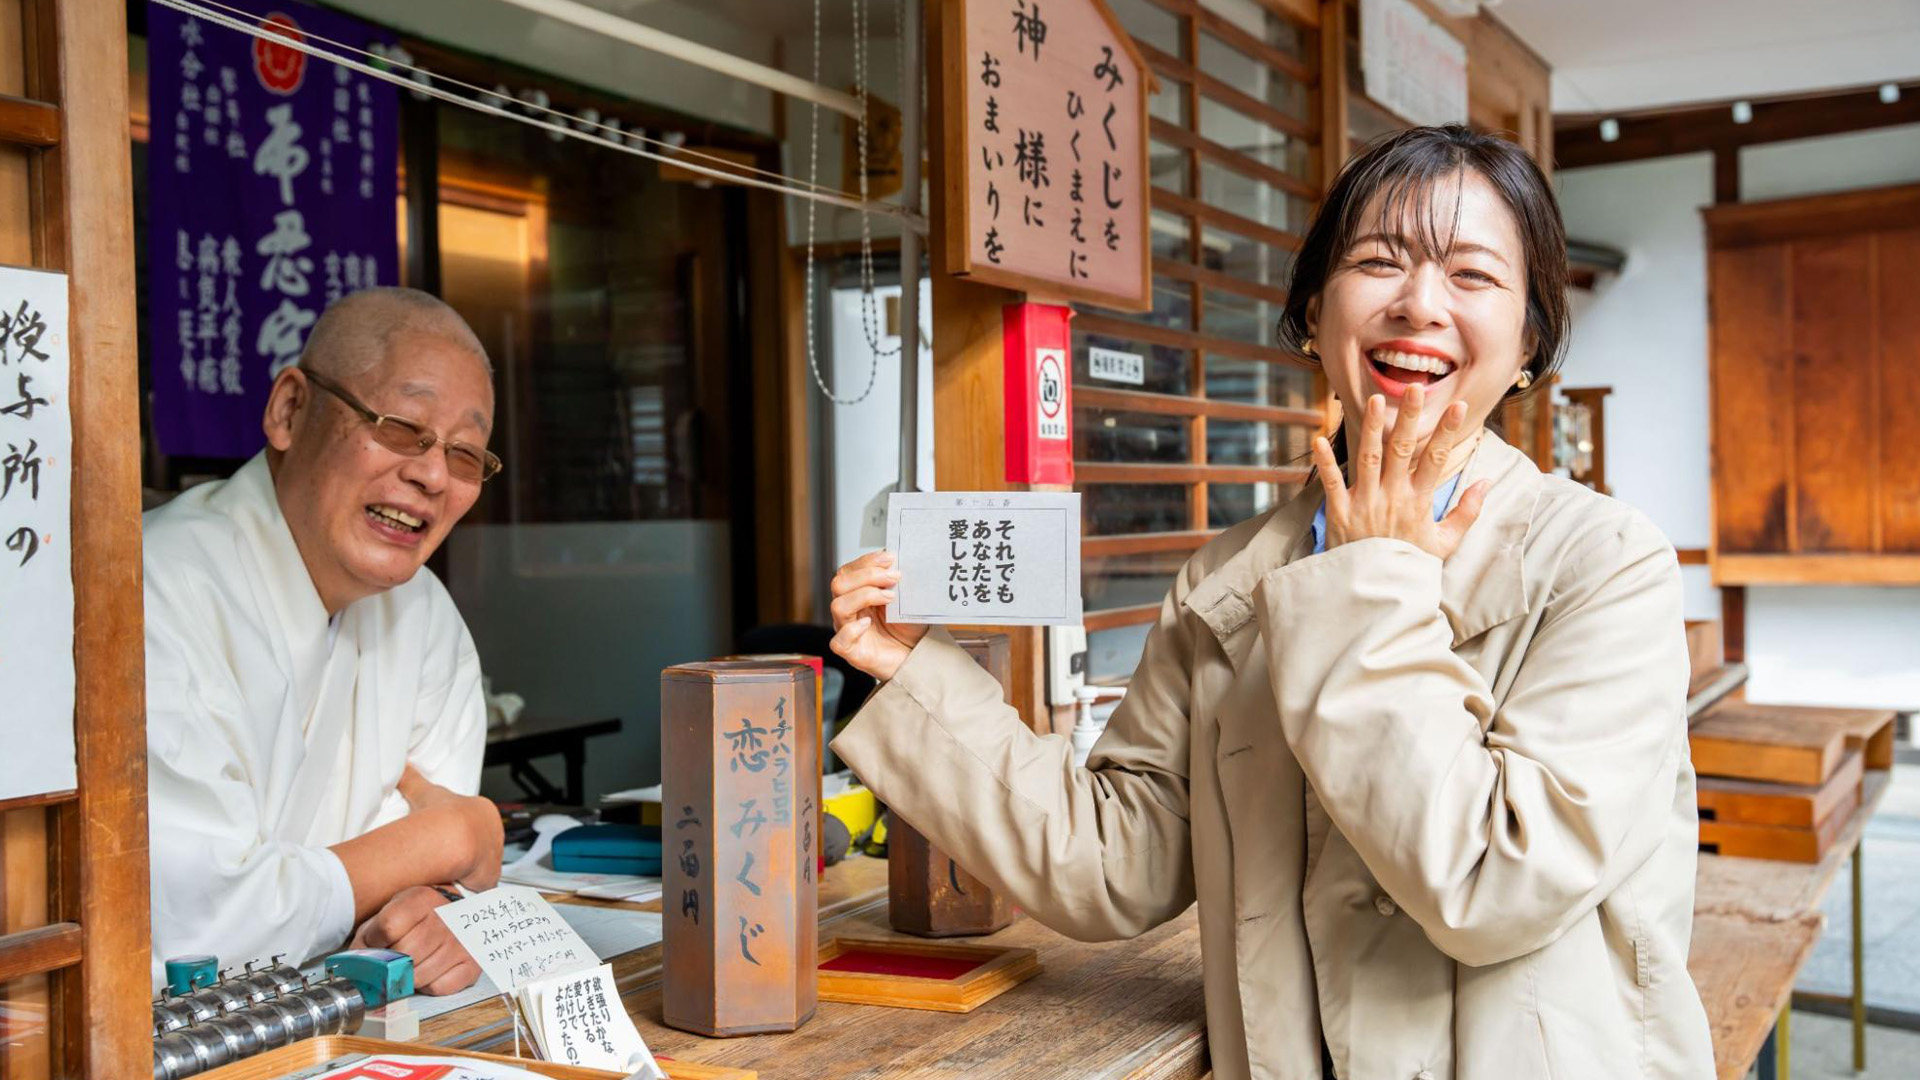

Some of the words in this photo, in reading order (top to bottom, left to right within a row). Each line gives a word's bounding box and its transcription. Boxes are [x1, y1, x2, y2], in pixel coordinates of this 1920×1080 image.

[981, 51, 1005, 264] おまいりを
[1066, 90, 1089, 279] ひくまえに
[1093, 45, 1124, 251] みくじを
[0, 299, 51, 568] 授与所の
[948, 519, 969, 607] 愛したい。
[971, 519, 992, 604] あなたを
[995, 519, 1015, 604] それでも
[770, 696, 793, 824] イチハラヒロコ
[723, 718, 770, 966] 恋みくじ
[555, 986, 581, 1065] よかったの
[564, 983, 578, 1030] だけで
[573, 980, 596, 1043] 愛してる
[592, 976, 611, 1023] 欲張り
